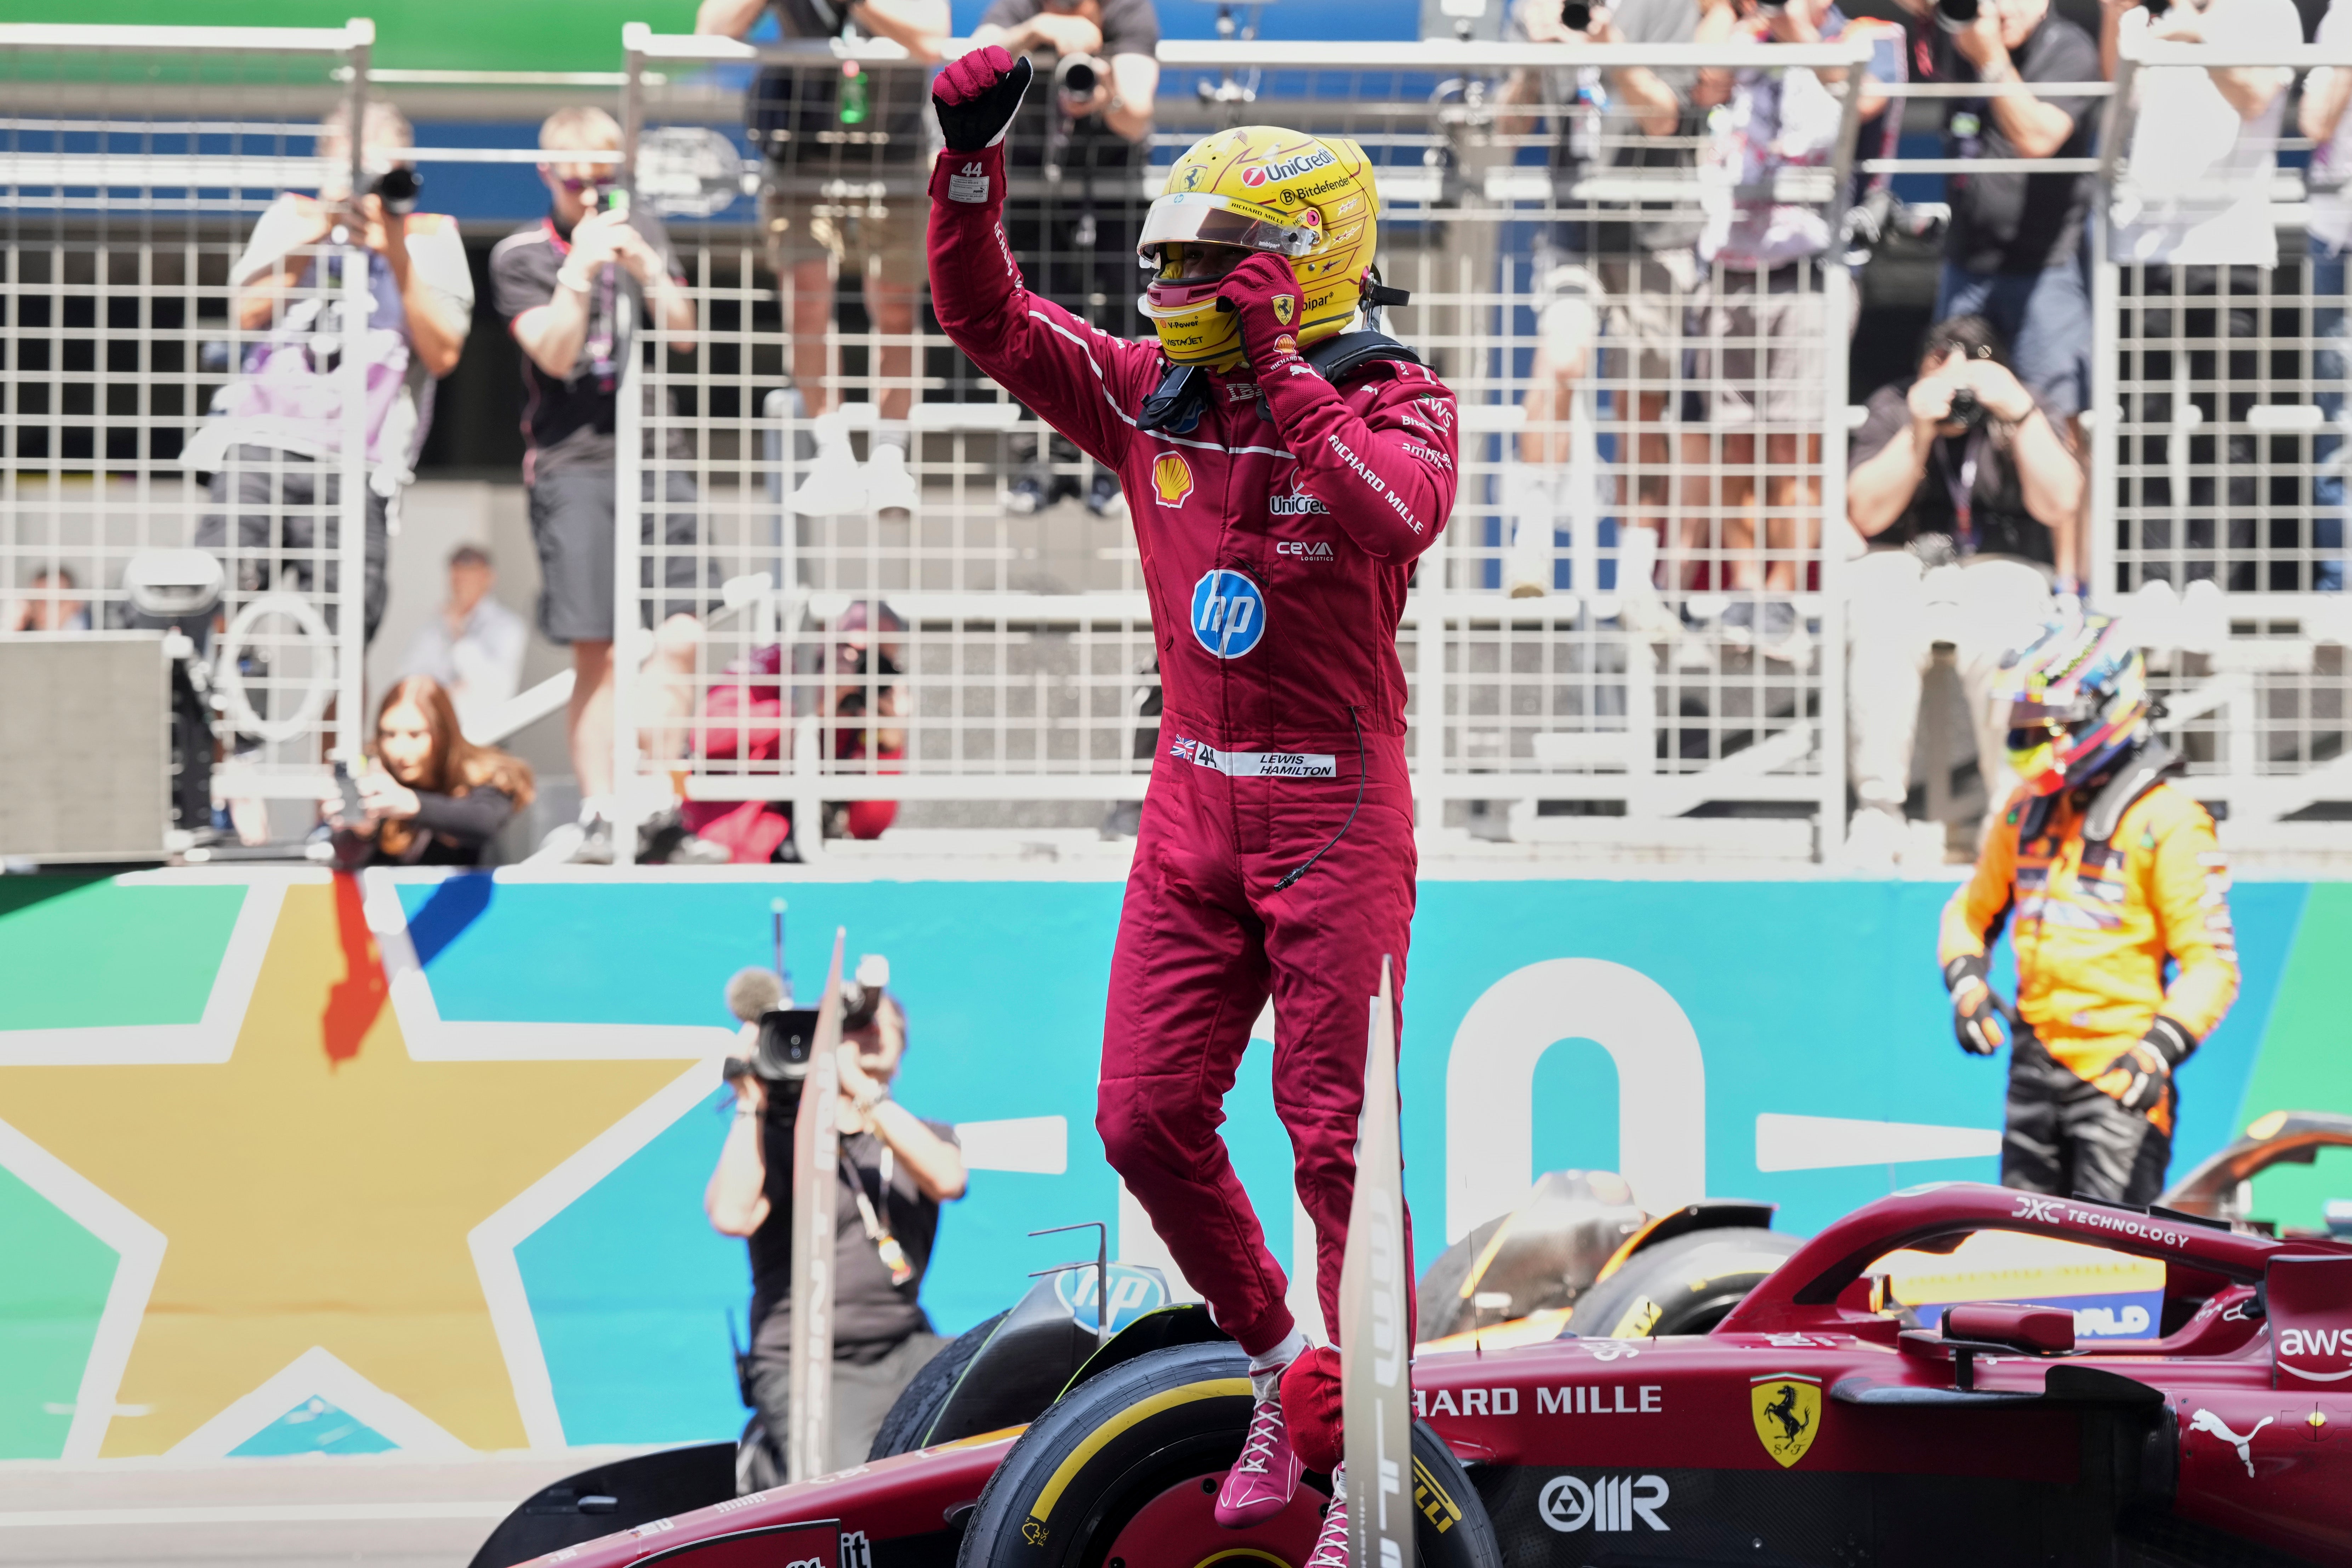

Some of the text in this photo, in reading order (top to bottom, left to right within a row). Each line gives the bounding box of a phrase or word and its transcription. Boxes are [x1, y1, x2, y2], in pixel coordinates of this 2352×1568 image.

[962, 162, 982, 177] 44
[1266, 148, 1335, 180] UniCredit
[1296, 176, 1350, 199] Bitdefender
[1174, 194, 1183, 203] hp
[1231, 203, 1262, 215] RICHARD
[1264, 213, 1284, 224] MILLE
[1293, 216, 1304, 226] HCL
[1270, 356, 1297, 370] RICHARD
[1328, 435, 1424, 535] RICHARD MILLE
[1200, 570, 1255, 658] hp
[1199, 746, 1217, 768] 44
[1260, 755, 1304, 764] LEWIS
[1260, 766, 1332, 775] HAMILTON
[2068, 1209, 2189, 1248] TECHNOLOGY
[1411, 1386, 1662, 1417] HARD MILLE
[1037, 1528, 1049, 1547] FSC
